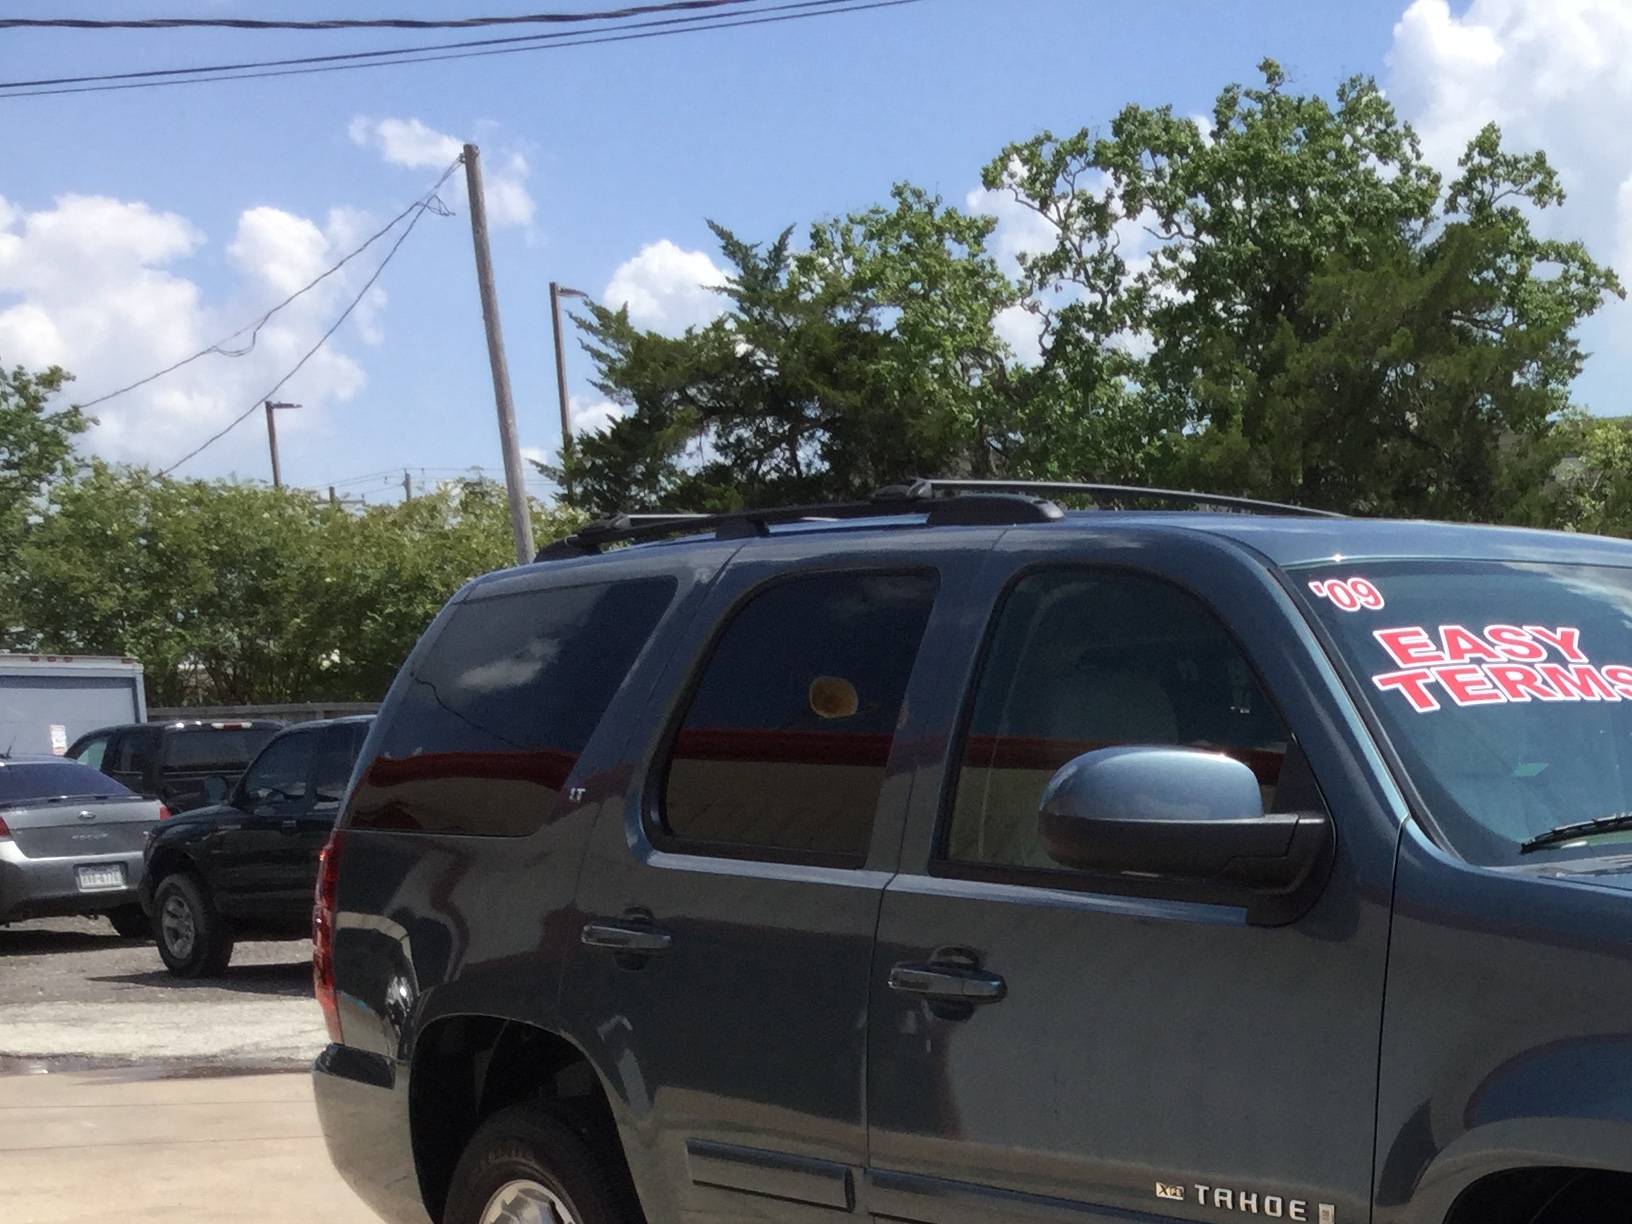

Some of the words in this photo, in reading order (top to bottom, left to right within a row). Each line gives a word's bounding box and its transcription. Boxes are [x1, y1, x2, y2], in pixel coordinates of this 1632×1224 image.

[1308, 576, 1385, 612] '09
[1372, 624, 1590, 670] EASY
[1193, 1183, 1308, 1222] TAHOE
